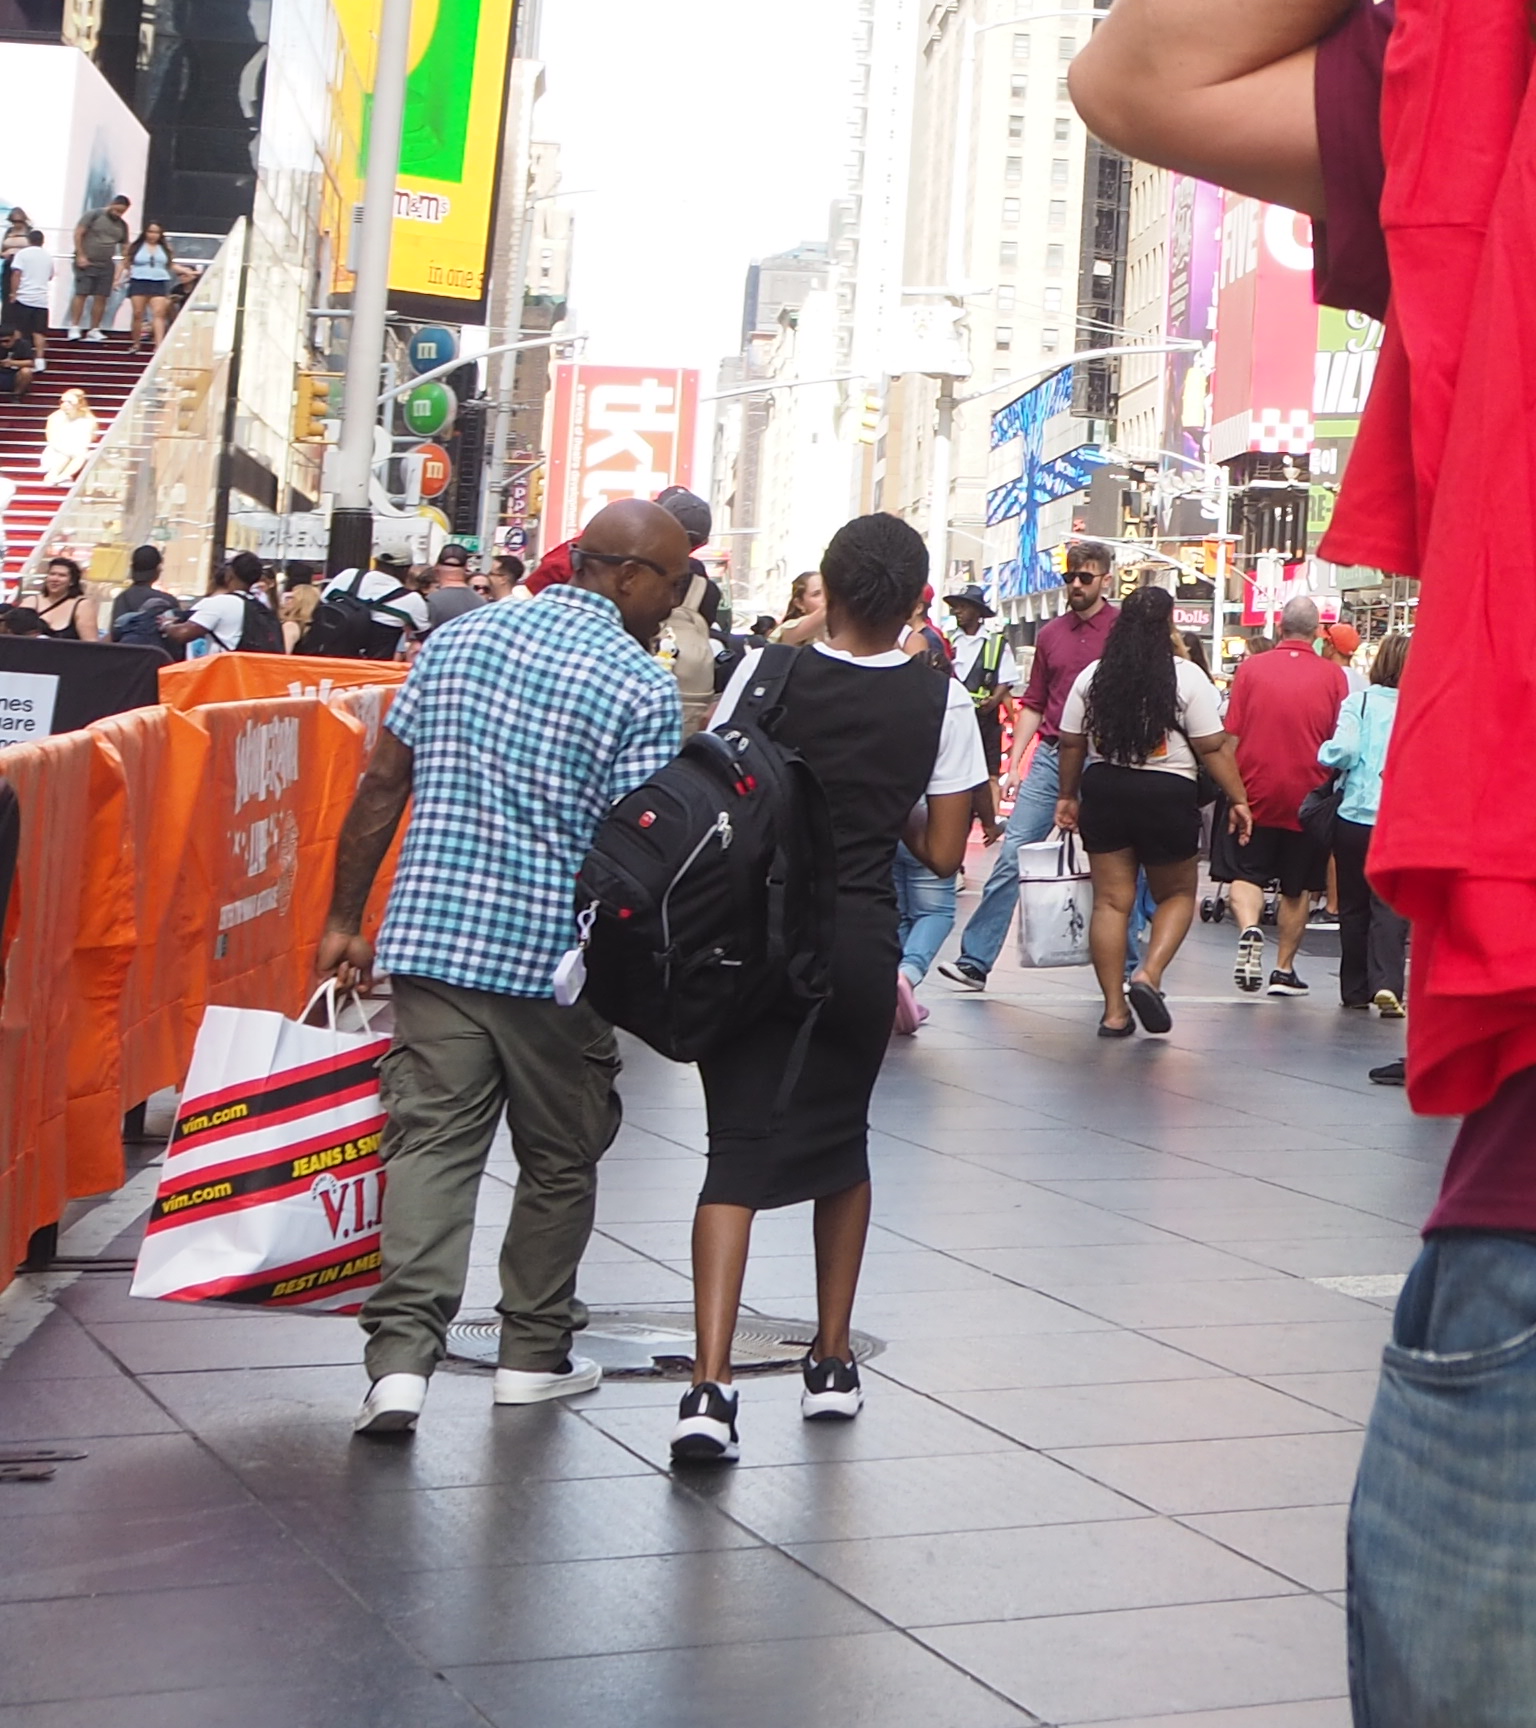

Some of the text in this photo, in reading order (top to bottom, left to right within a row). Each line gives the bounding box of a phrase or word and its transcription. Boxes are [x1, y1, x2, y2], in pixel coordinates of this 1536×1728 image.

[582, 378, 675, 530] tkt
[292, 1149, 342, 1178] JEANS
[345, 1143, 356, 1161] &
[162, 1183, 232, 1213] vim.com
[272, 1275, 316, 1297] BEST
[318, 1266, 340, 1284] IN
